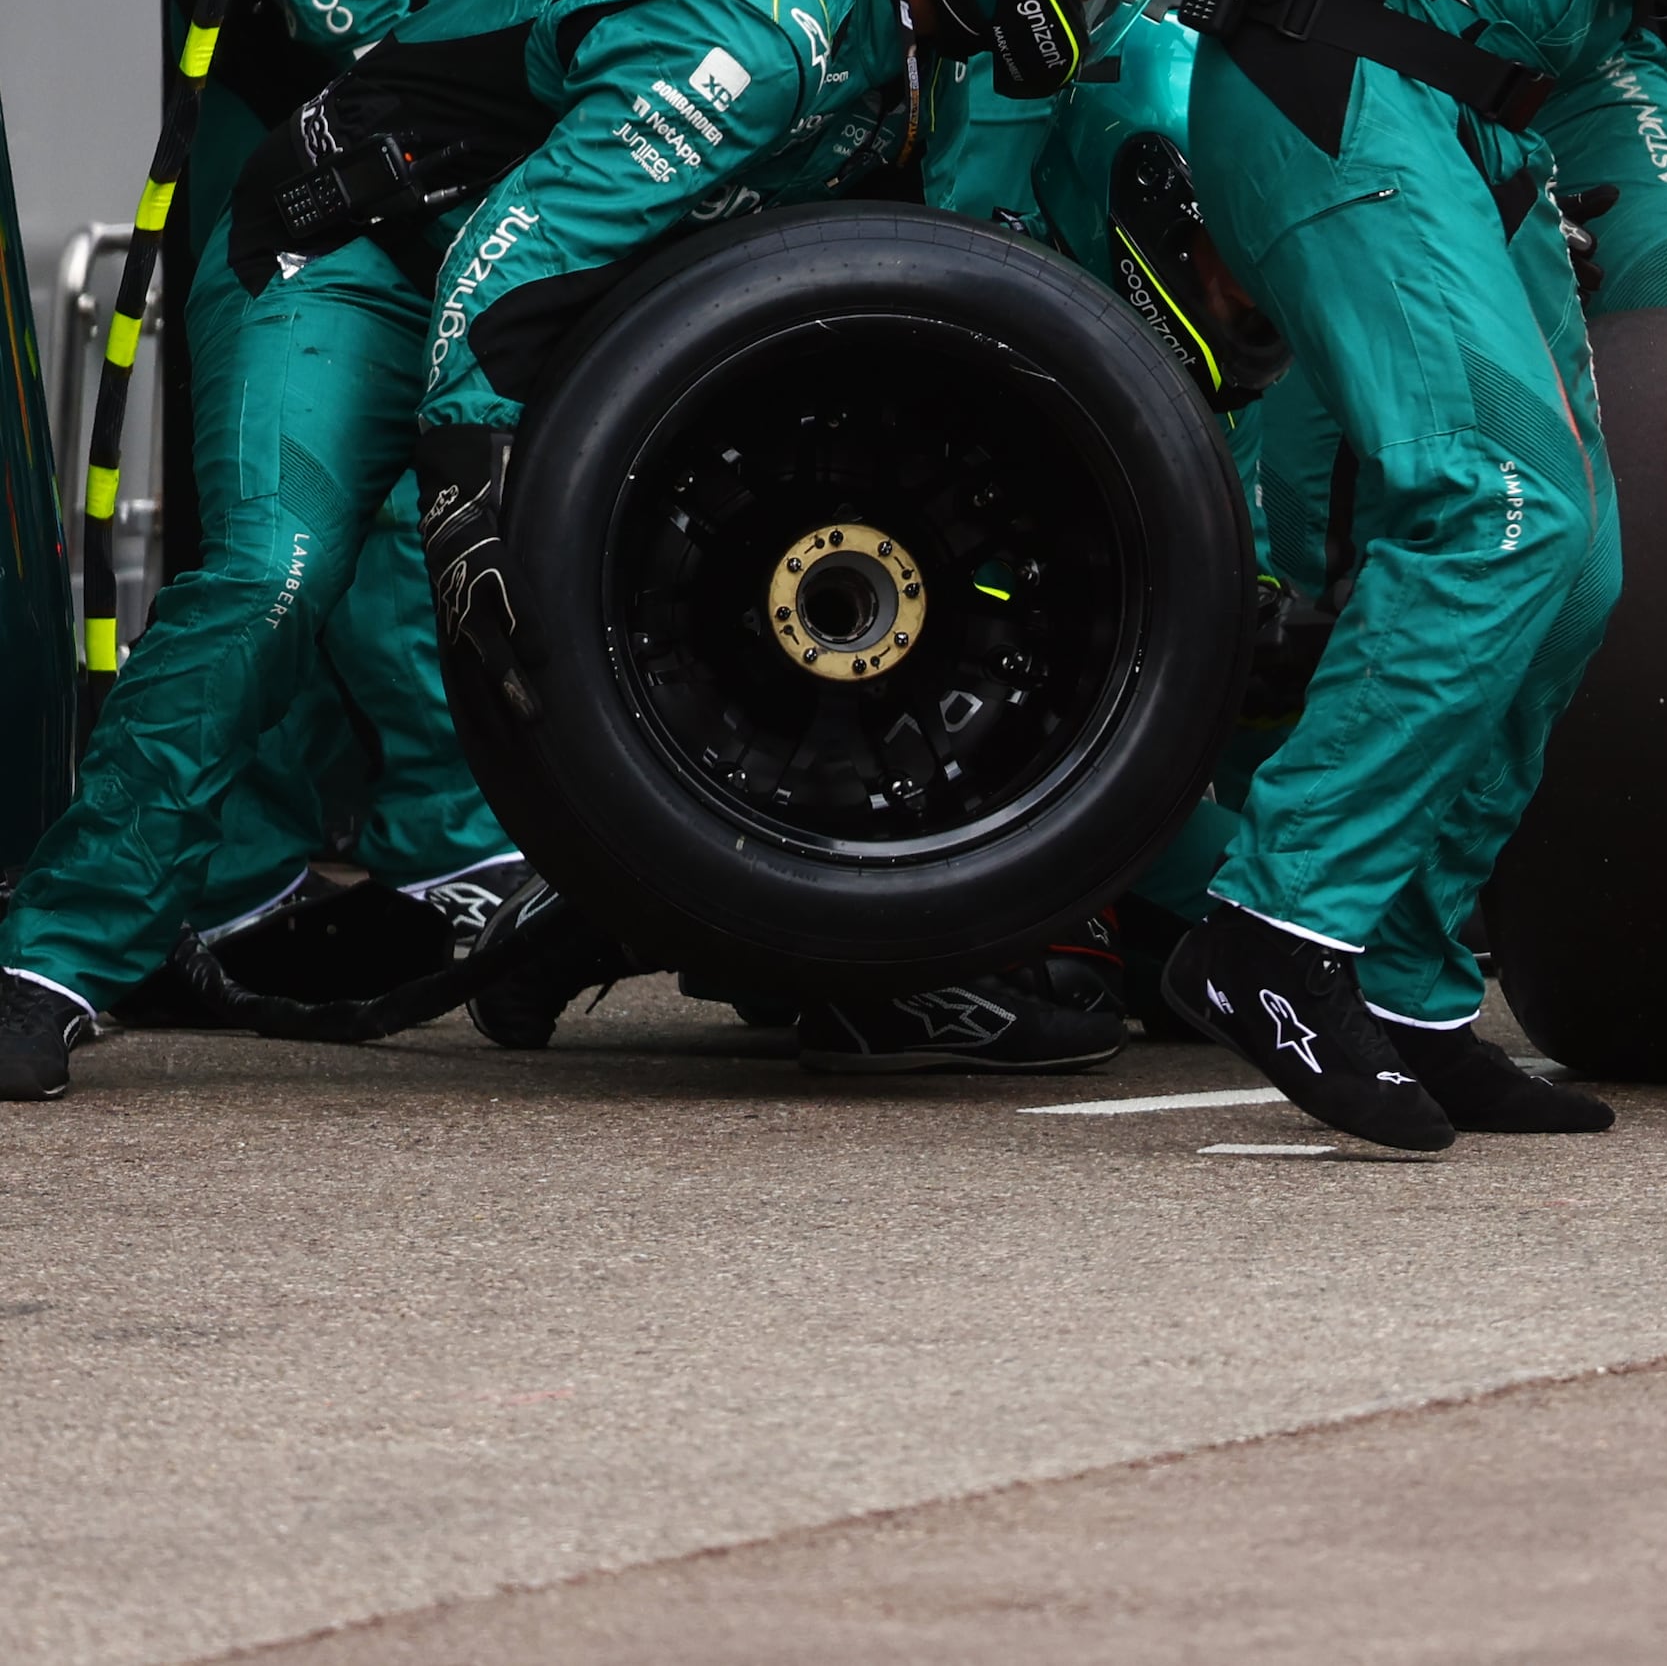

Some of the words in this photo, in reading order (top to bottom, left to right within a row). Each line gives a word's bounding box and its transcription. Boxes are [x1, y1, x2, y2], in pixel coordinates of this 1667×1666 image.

[992, 25, 1010, 52] MARK
[646, 110, 702, 168] NetApp
[651, 79, 724, 146] BOMBARDIER
[1119, 258, 1196, 371] cognizant
[1500, 460, 1523, 552] SIMPSON
[269, 532, 311, 631] LAMBERT
